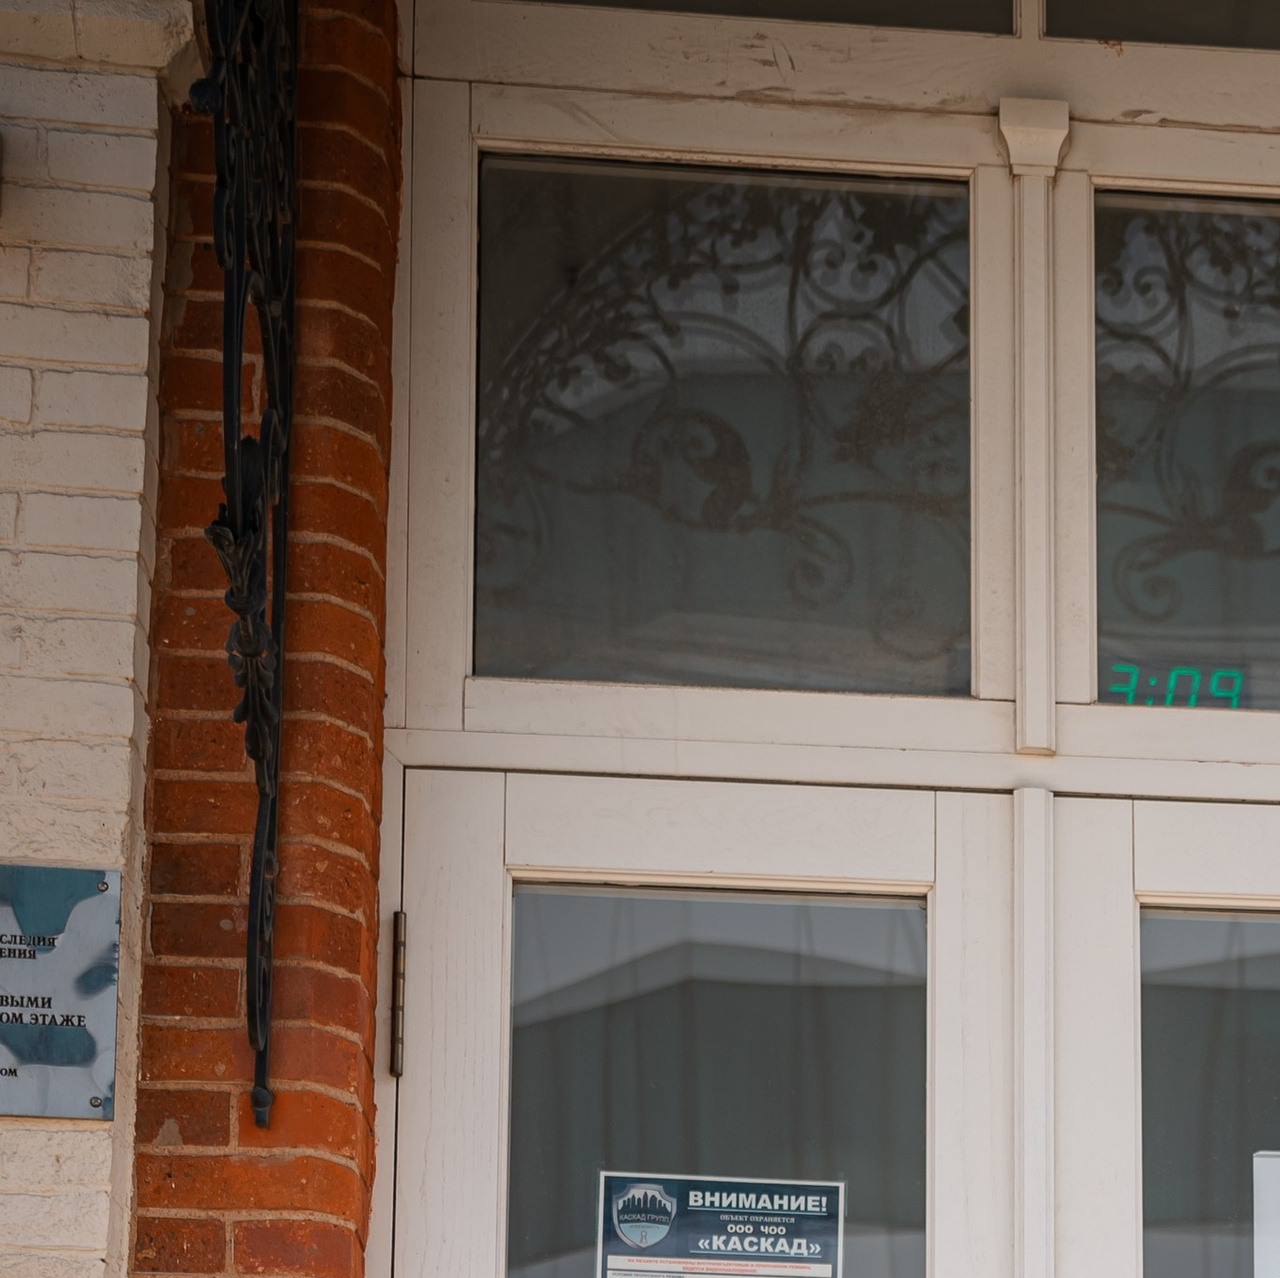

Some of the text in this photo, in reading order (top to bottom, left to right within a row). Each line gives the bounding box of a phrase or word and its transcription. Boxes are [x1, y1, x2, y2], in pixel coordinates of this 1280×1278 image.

[0, 934, 58, 947] СЛЕДИЯ
[0, 948, 37, 960] ЕНИЯ
[0, 995, 53, 1009] ВЫМИ
[29, 1013, 86, 1028] ЭТАЖЕ
[688, 1190, 827, 1212] ВНИМАНИЕ!
[619, 1213, 646, 1222] КАСКАД
[720, 1214, 749, 1222] ОБЪЕКТ
[727, 1224, 787, 1235] ООО ЧОО
[698, 1235, 821, 1256] «КАСКАД»
